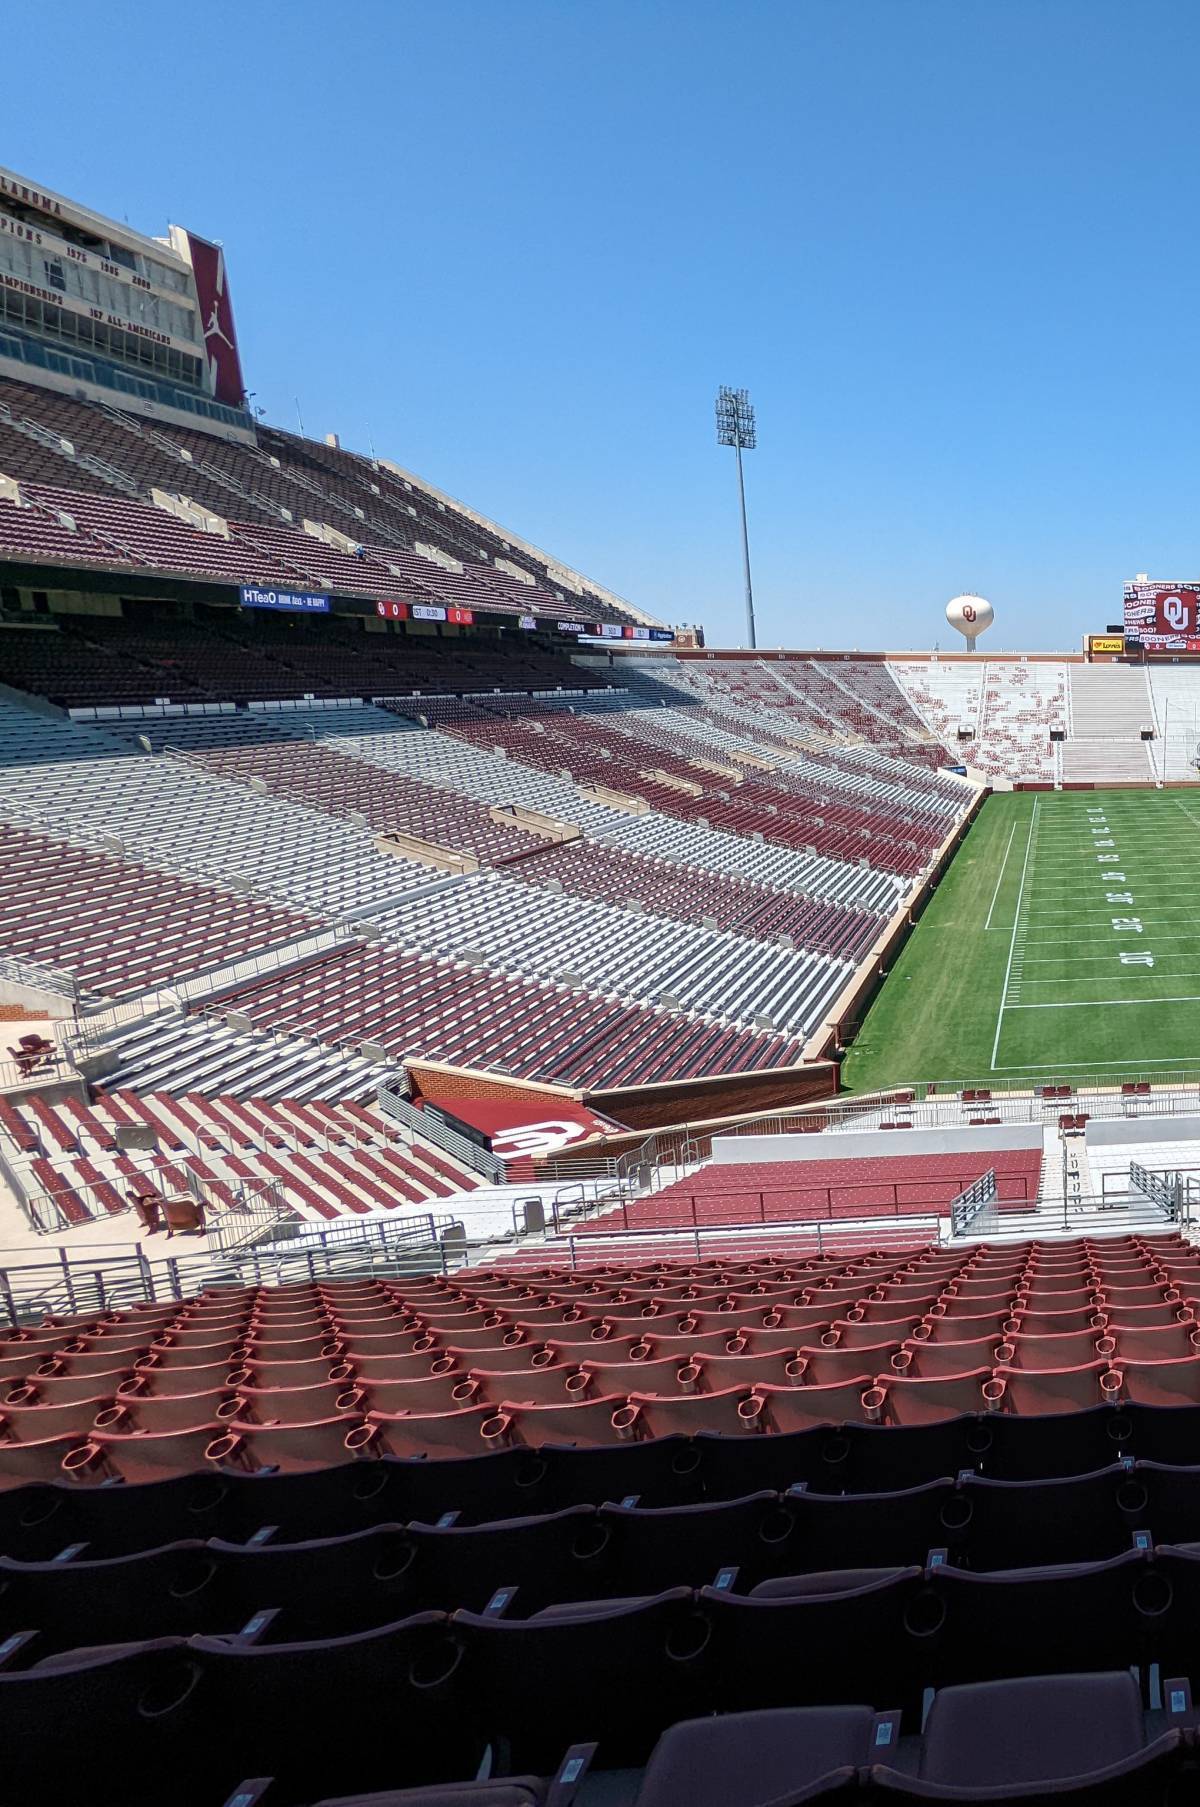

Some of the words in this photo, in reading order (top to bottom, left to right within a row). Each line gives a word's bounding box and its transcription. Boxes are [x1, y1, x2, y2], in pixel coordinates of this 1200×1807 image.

[243, 589, 276, 604] HTeaO
[393, 603, 399, 616] 0
[1164, 597, 1189, 630] OU
